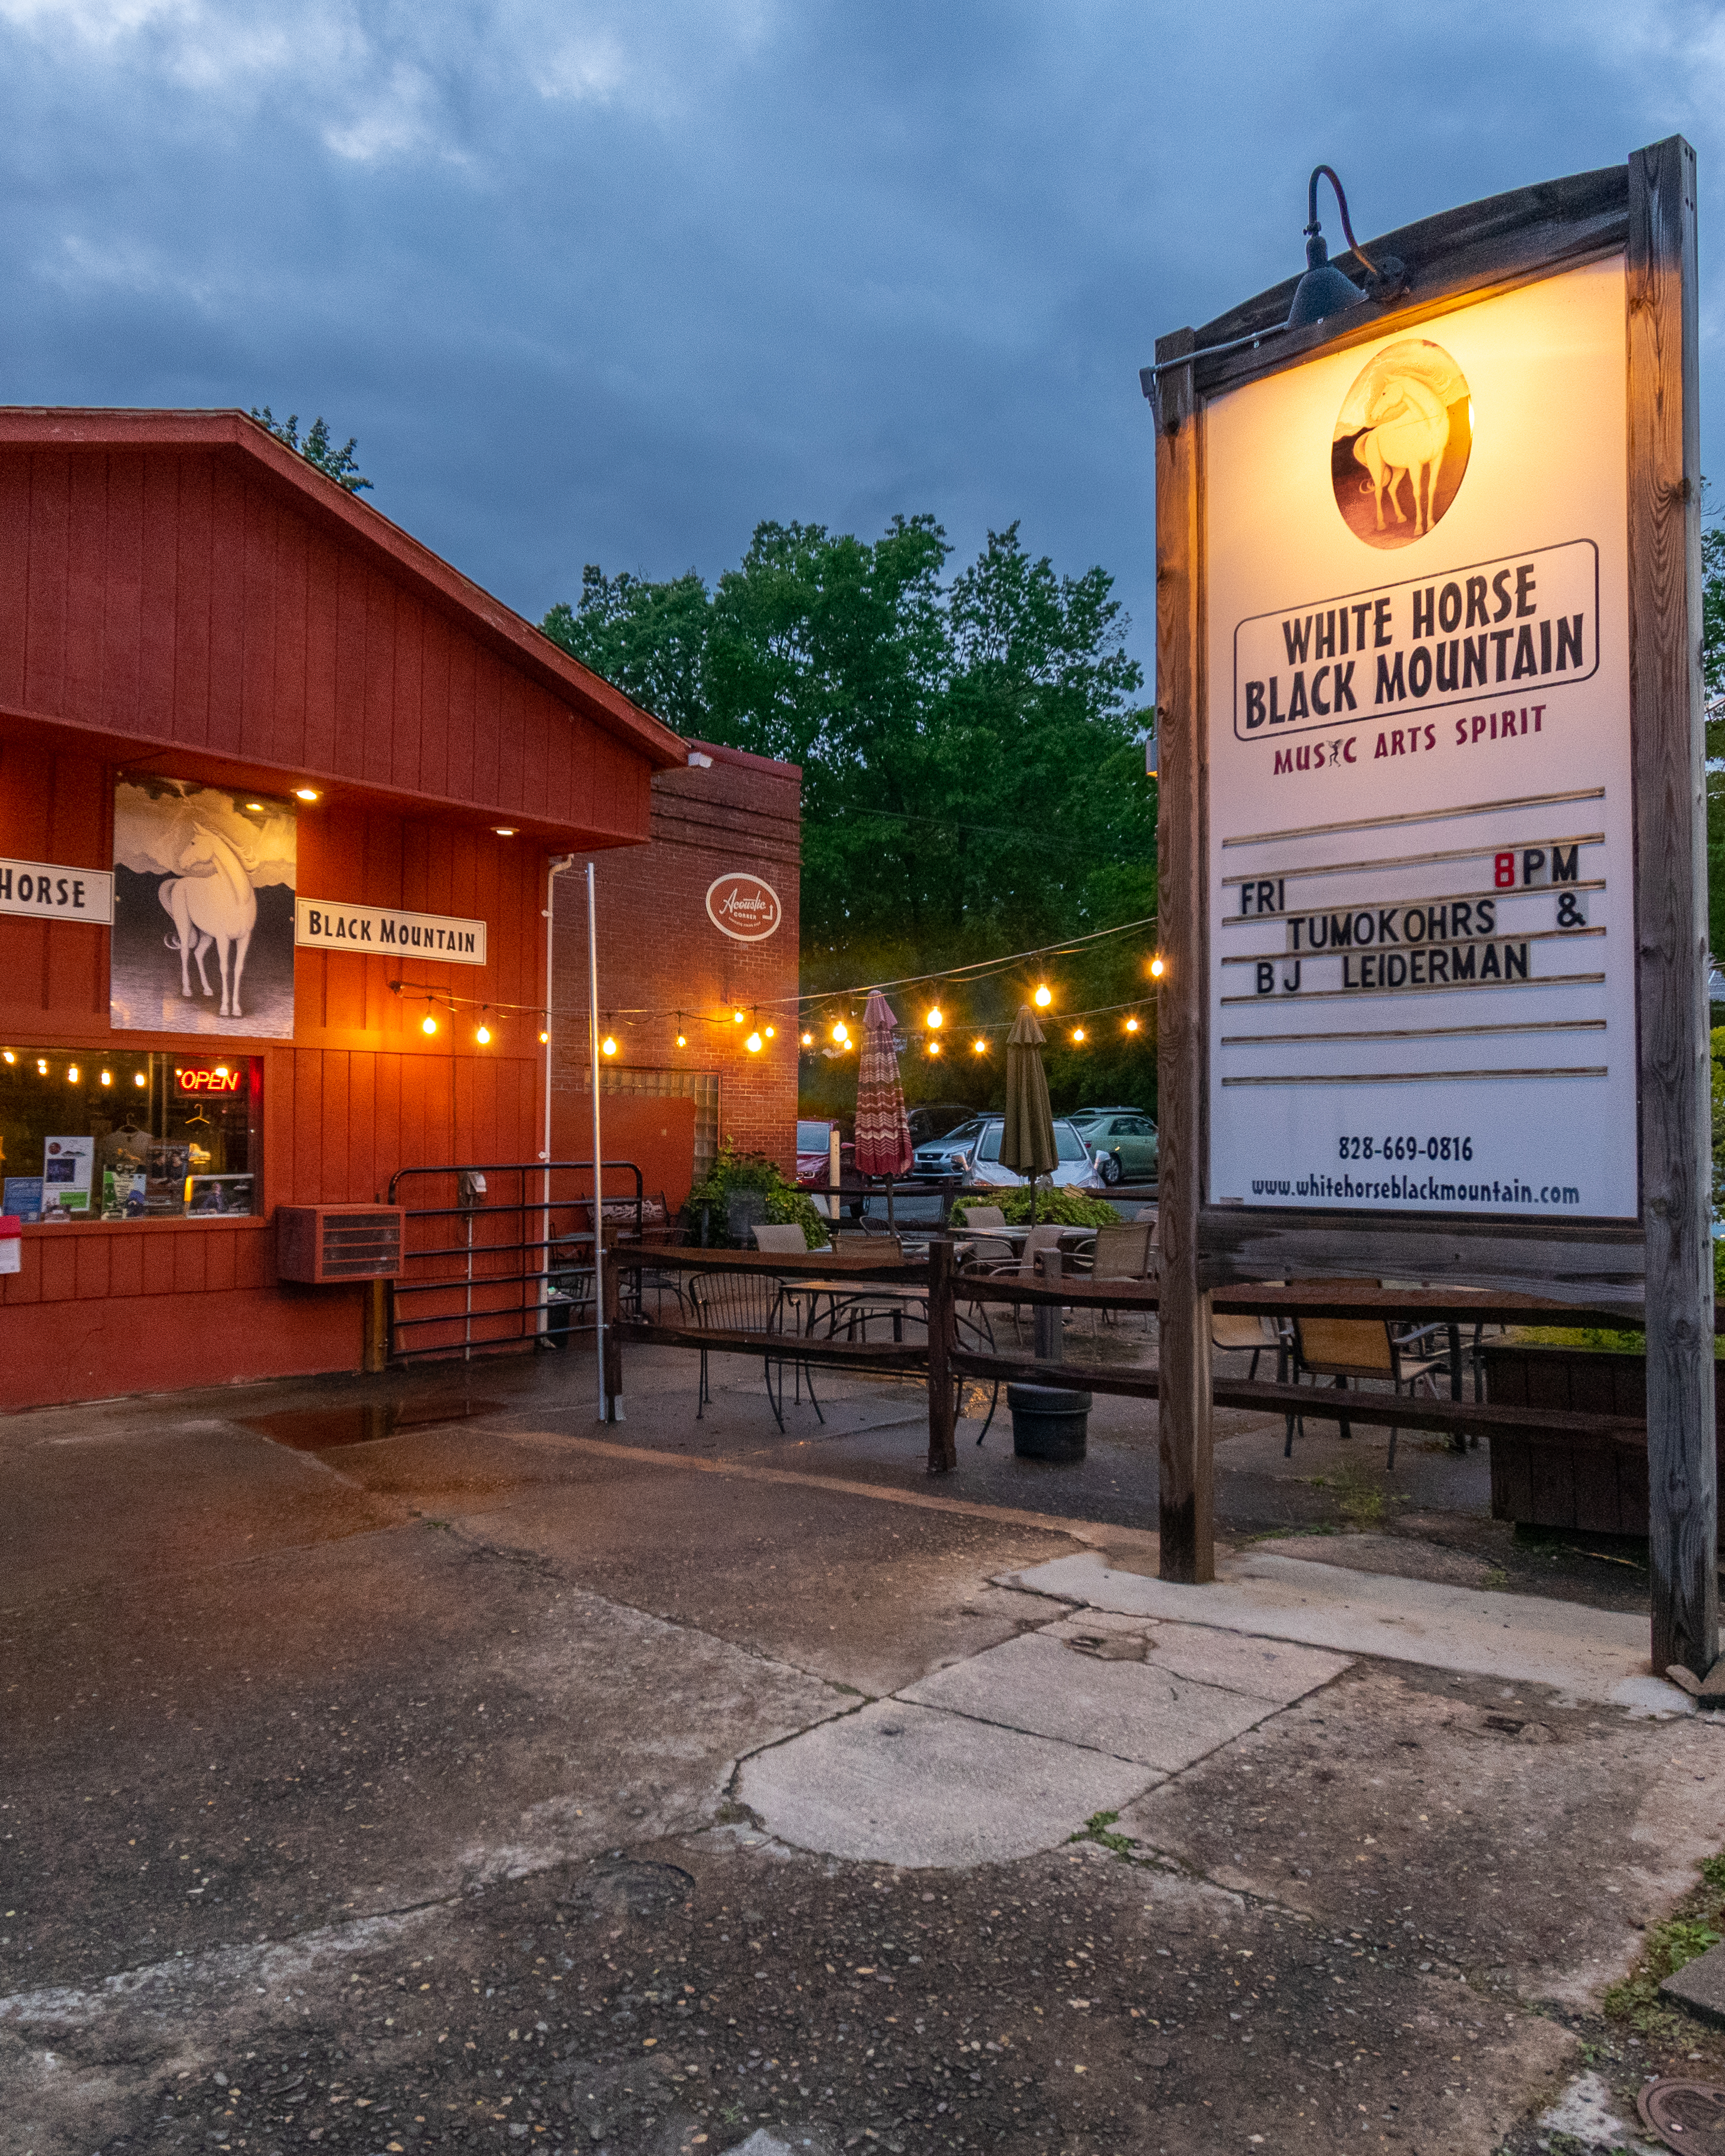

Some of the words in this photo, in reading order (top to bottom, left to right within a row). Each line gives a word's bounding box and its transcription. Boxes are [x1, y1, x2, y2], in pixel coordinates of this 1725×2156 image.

[1282, 597, 1392, 666] WHITE
[1412, 564, 1537, 640] HORSE
[1245, 660, 1358, 729] BLACK
[1374, 613, 1584, 704] MOUNTAIN
[1374, 724, 1436, 759] ARTS
[1456, 705, 1547, 745] SPIRIT
[0, 868, 85, 908] HORSE
[719, 888, 766, 914] Acoustic
[1241, 879, 1285, 915] FRI
[734, 912, 756, 920] CORNER
[1287, 899, 1495, 950] TUMOKOHRS
[1557, 892, 1586, 927] &
[1342, 943, 1528, 989] LEIDERMAN
[181, 1071, 239, 1090] OPEN
[1339, 1136, 1474, 1162] 828-669-0816
[1252, 1173, 1580, 1205] www.whitehorseblackmountain.com
